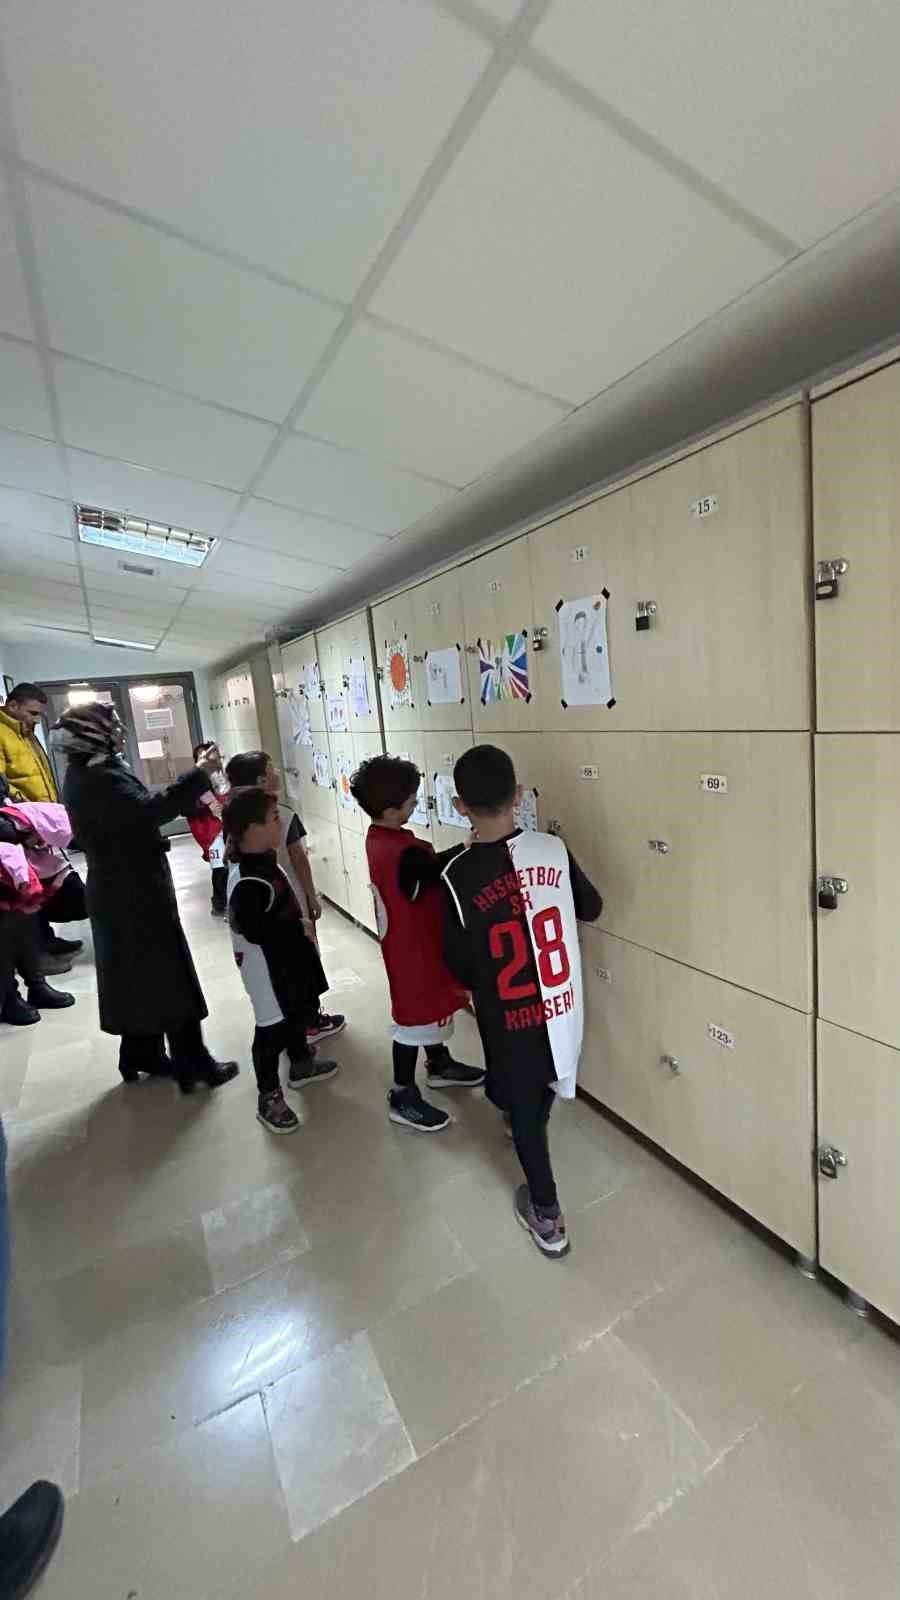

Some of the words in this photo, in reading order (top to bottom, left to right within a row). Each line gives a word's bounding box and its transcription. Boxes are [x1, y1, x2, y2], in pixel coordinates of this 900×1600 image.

[697, 499, 711, 515] 15
[707, 778, 720, 790] 69
[511, 890, 534, 915] SK
[488, 905, 571, 1002] 28
[711, 1024, 729, 1045] 123
